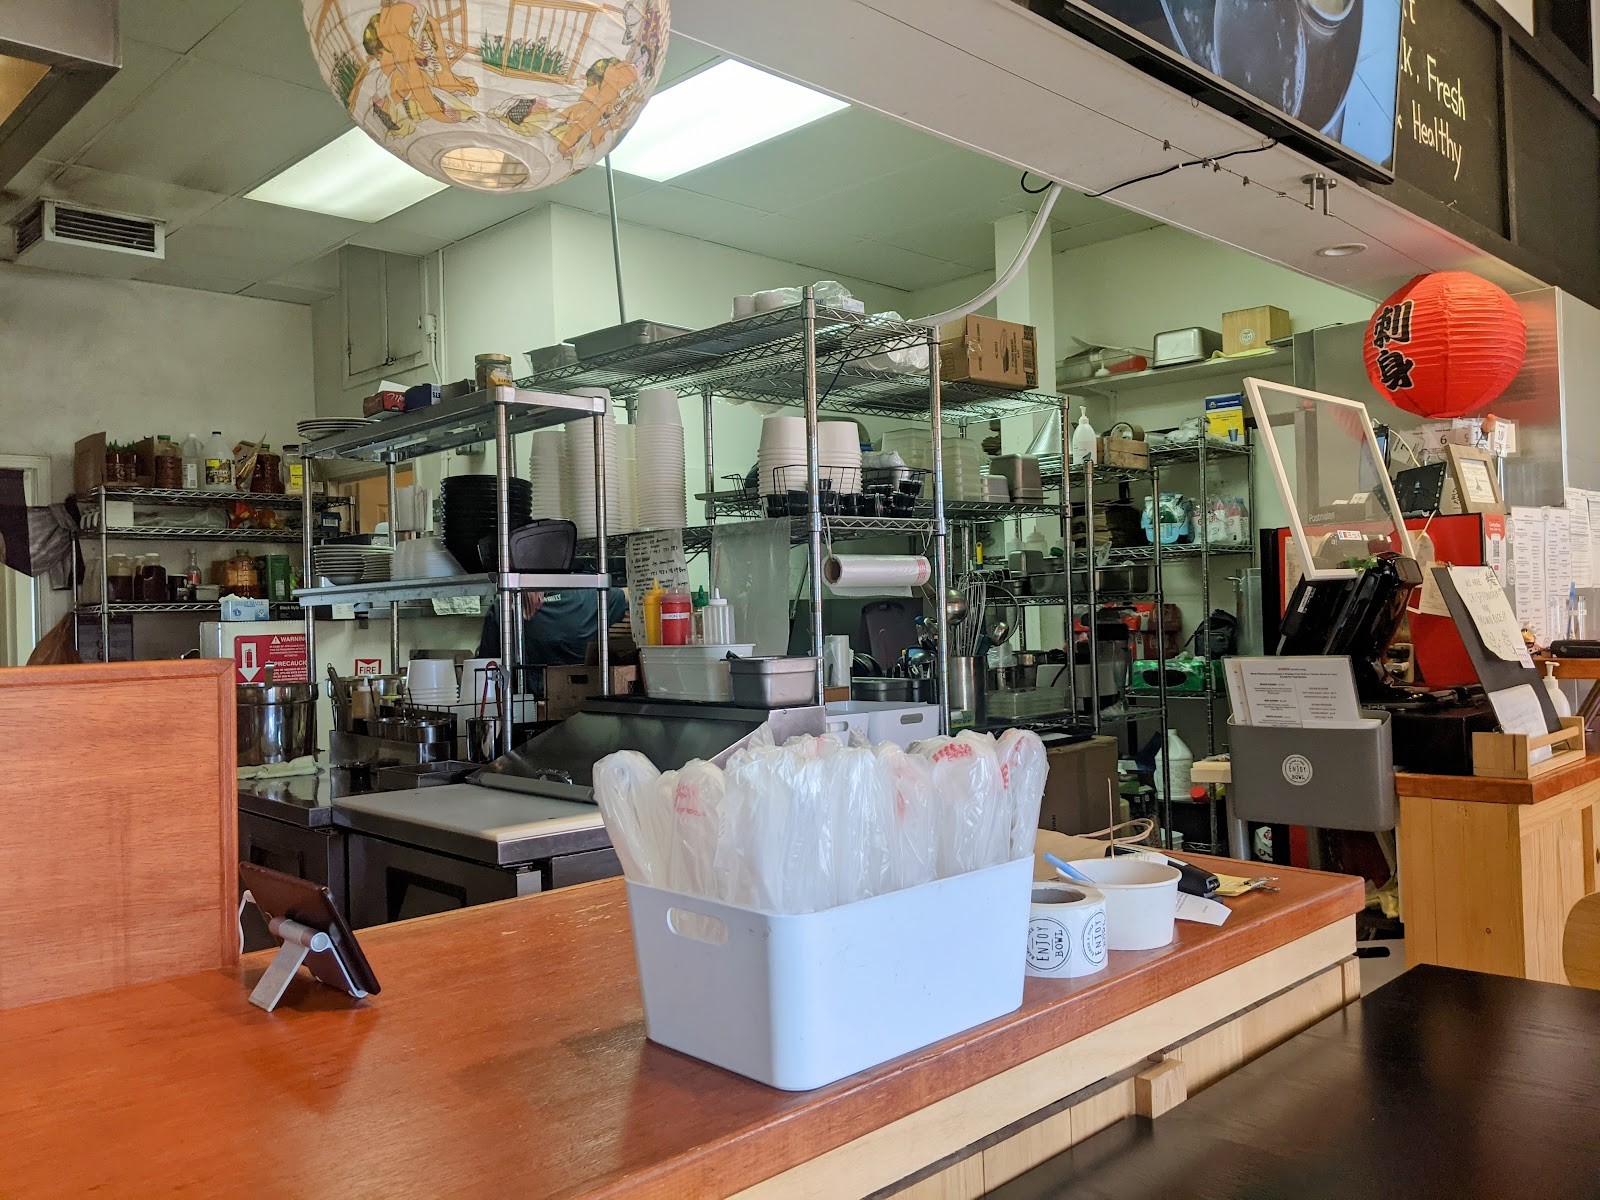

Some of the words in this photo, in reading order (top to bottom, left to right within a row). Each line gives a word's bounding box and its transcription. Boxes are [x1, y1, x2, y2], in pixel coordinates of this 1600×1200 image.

[1426, 53, 1466, 121] Fresh
[1411, 100, 1462, 182] Healthy
[1440, 434, 1448, 444] 6
[1308, 512, 1336, 522] Postmates
[360, 666, 377, 675] FIRE
[1036, 926, 1050, 961] ENJOY
[1055, 930, 1063, 957] BOWL
[1094, 920, 1102, 956] ENJOY
